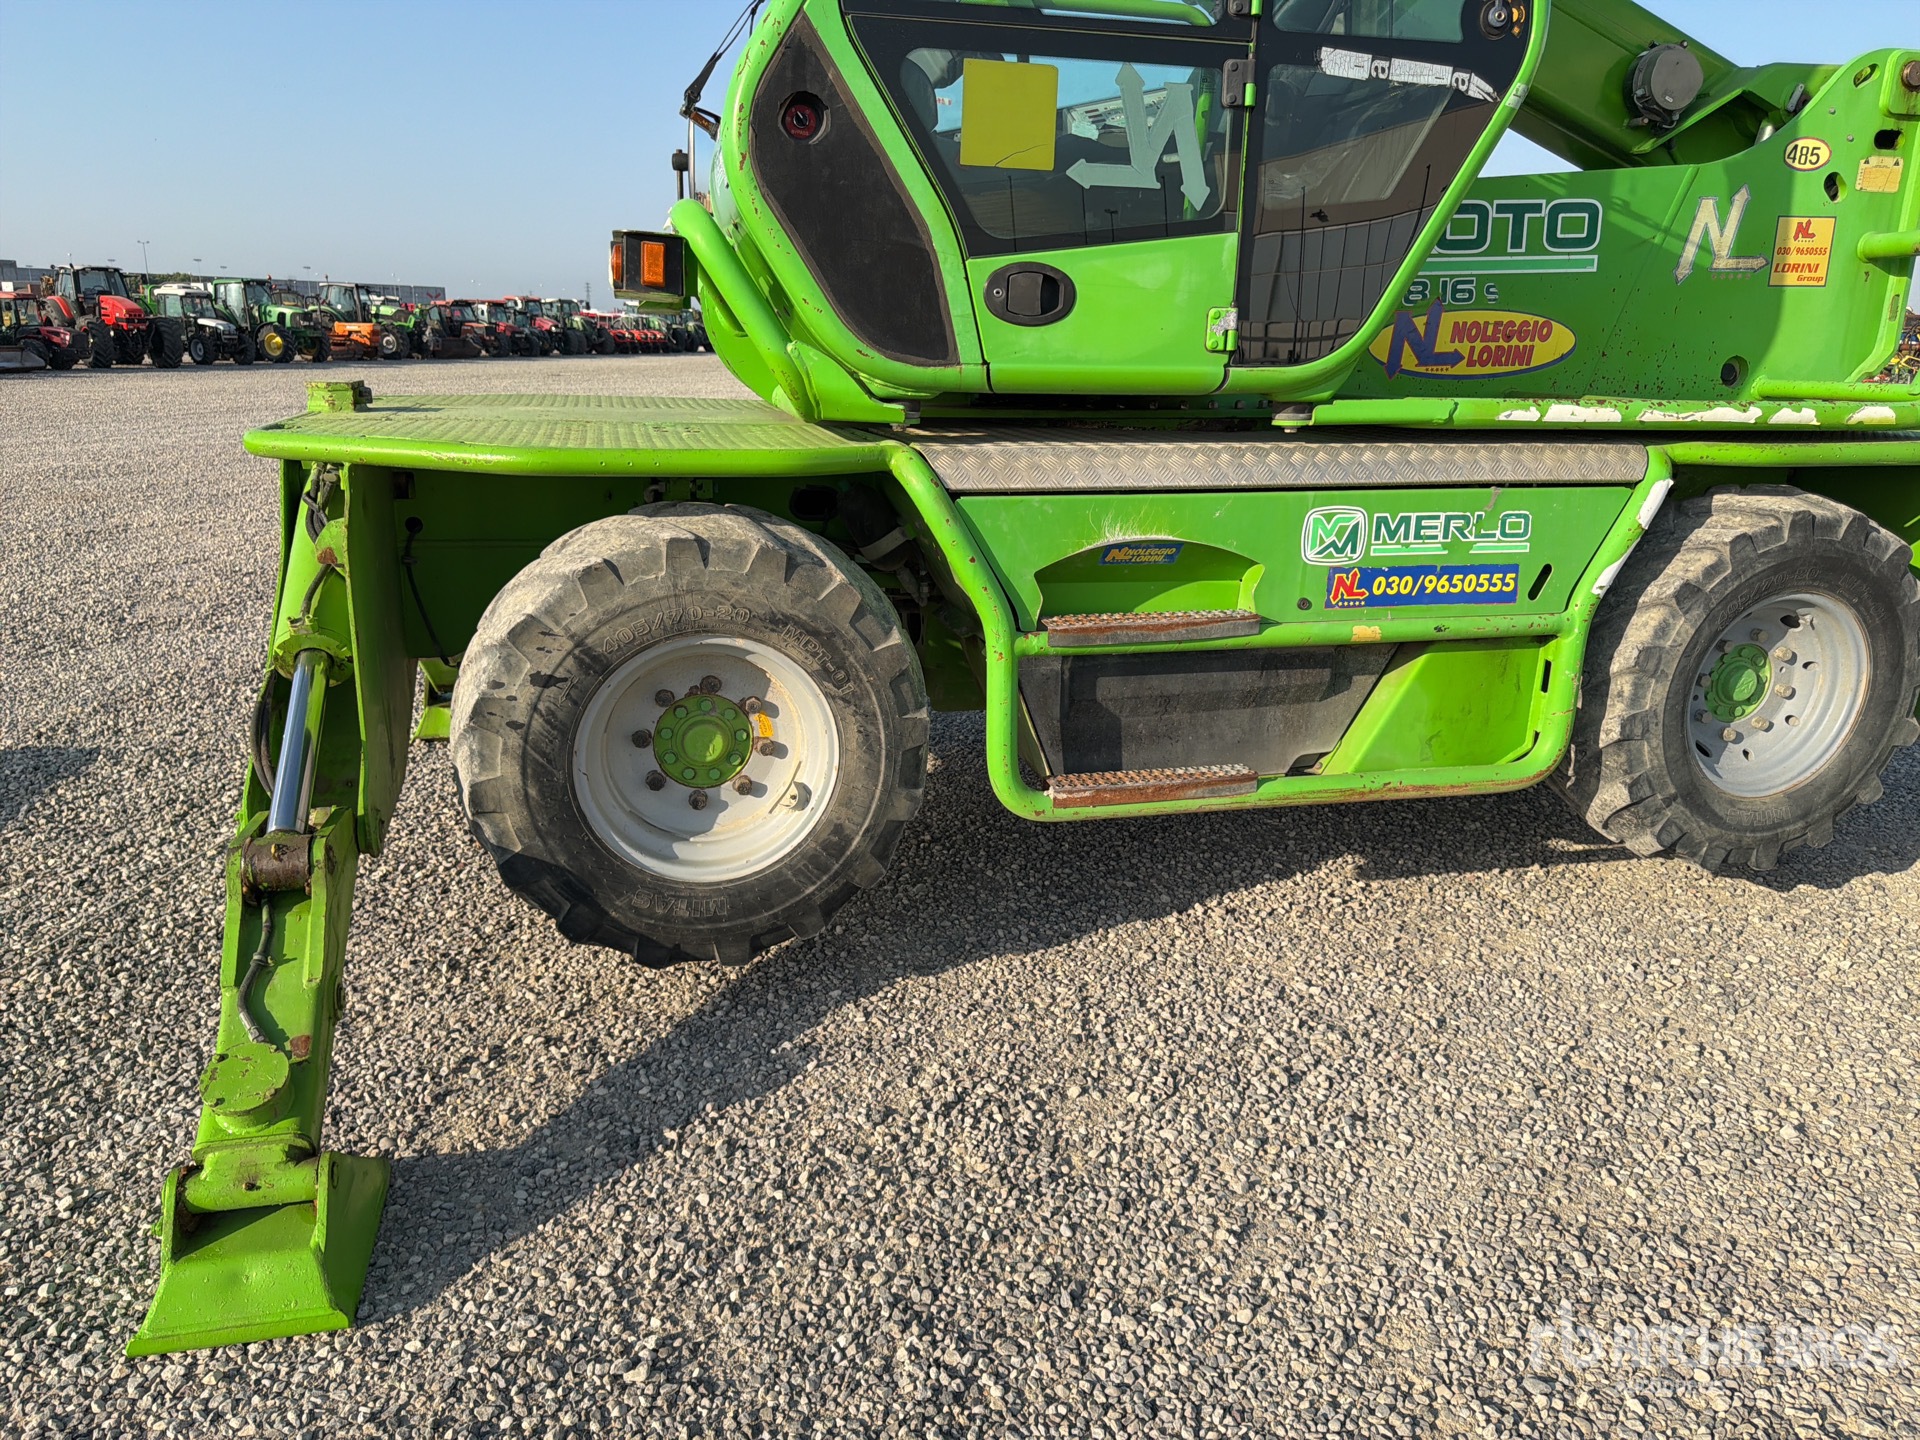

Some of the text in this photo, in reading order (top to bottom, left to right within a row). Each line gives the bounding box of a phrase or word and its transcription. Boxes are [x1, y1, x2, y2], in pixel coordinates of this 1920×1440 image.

[1786, 144, 1821, 166] 485
[1430, 198, 1603, 254] OTO
[1776, 246, 1828, 256] 030/9650555
[1773, 262, 1820, 273] LORINI
[1796, 274, 1824, 283] Group
[1450, 319, 1553, 344] NOLEGGIO
[1465, 345, 1536, 368] LORINI
[1371, 510, 1533, 544] MERLO
[1126, 547, 1177, 556] NOLEGGIO
[1131, 554, 1165, 562] LORINI
[1372, 573, 1517, 596] 030/9650555
[601, 605, 751, 655] 405/70-20
[781, 623, 855, 696] MPT-01
[631, 888, 728, 918] MITAS
